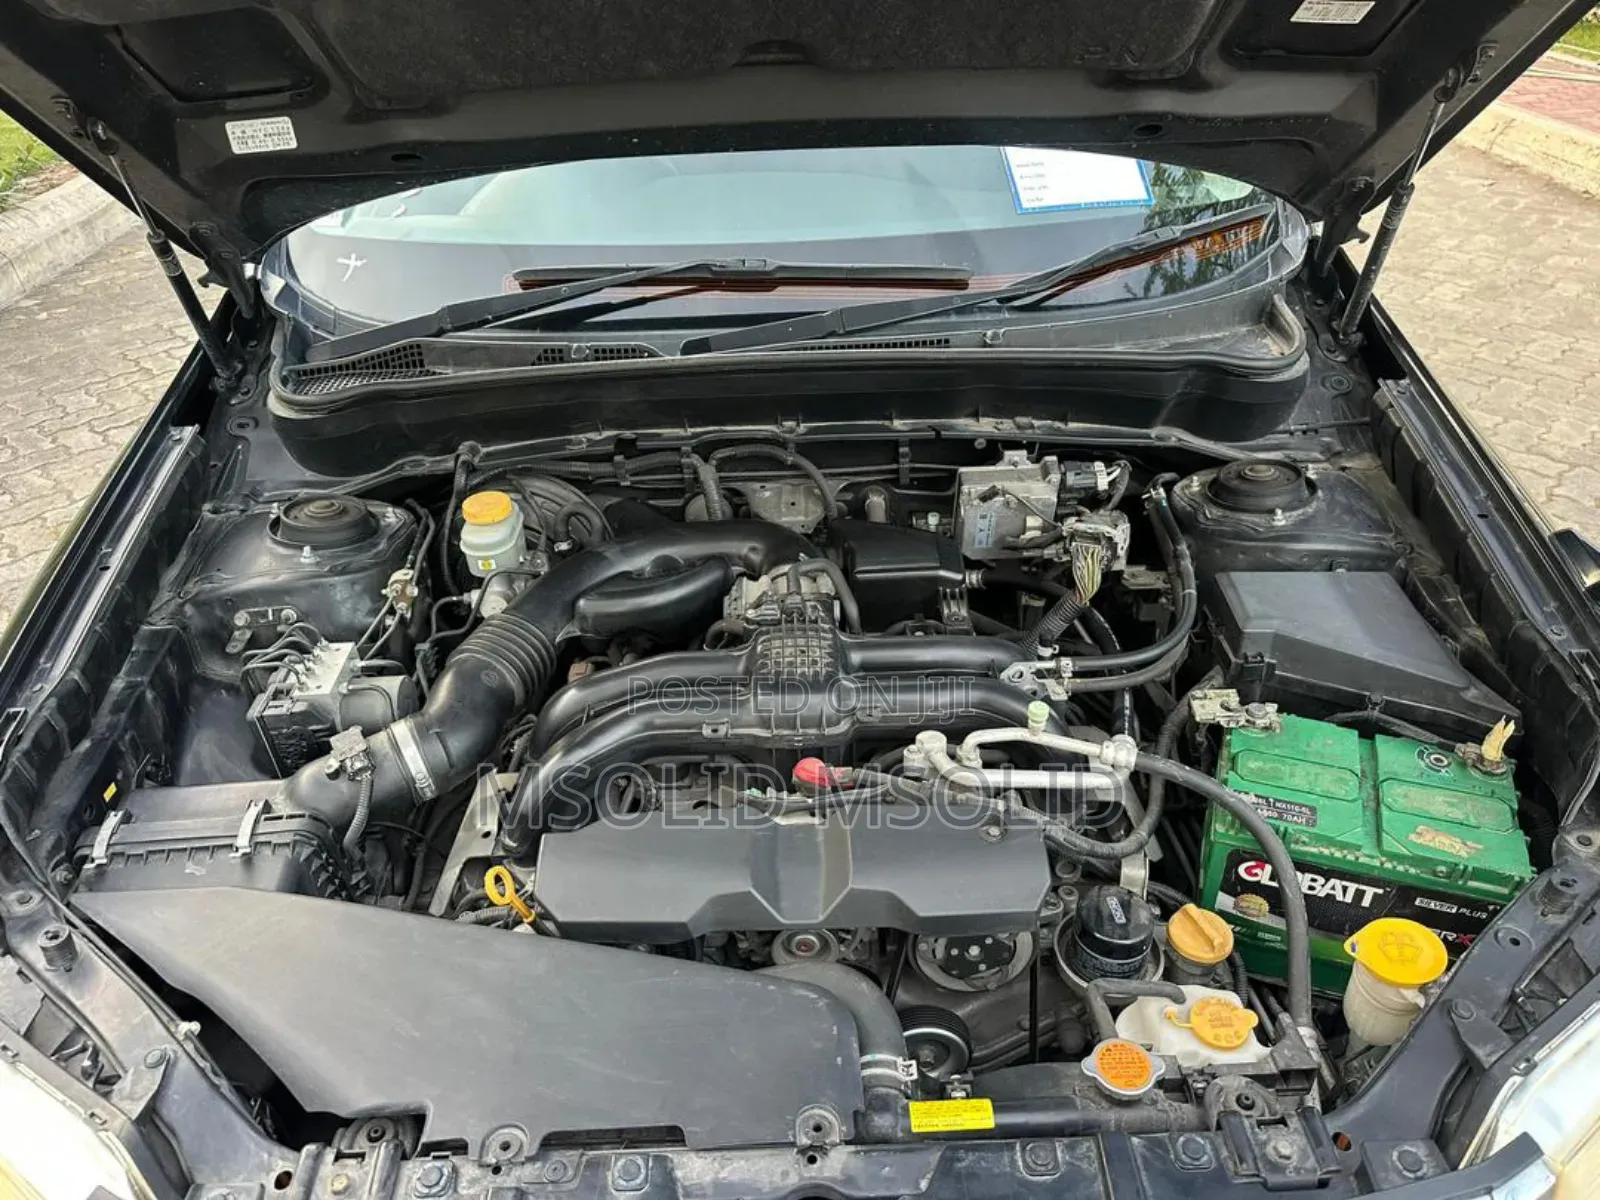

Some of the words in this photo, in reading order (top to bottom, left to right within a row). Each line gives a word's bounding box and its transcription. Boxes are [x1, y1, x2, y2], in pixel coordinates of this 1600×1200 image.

[1237, 860, 1385, 908] GLBATT
[1416, 898, 1457, 913] SILVER
[1458, 907, 1488, 919] PLUS
